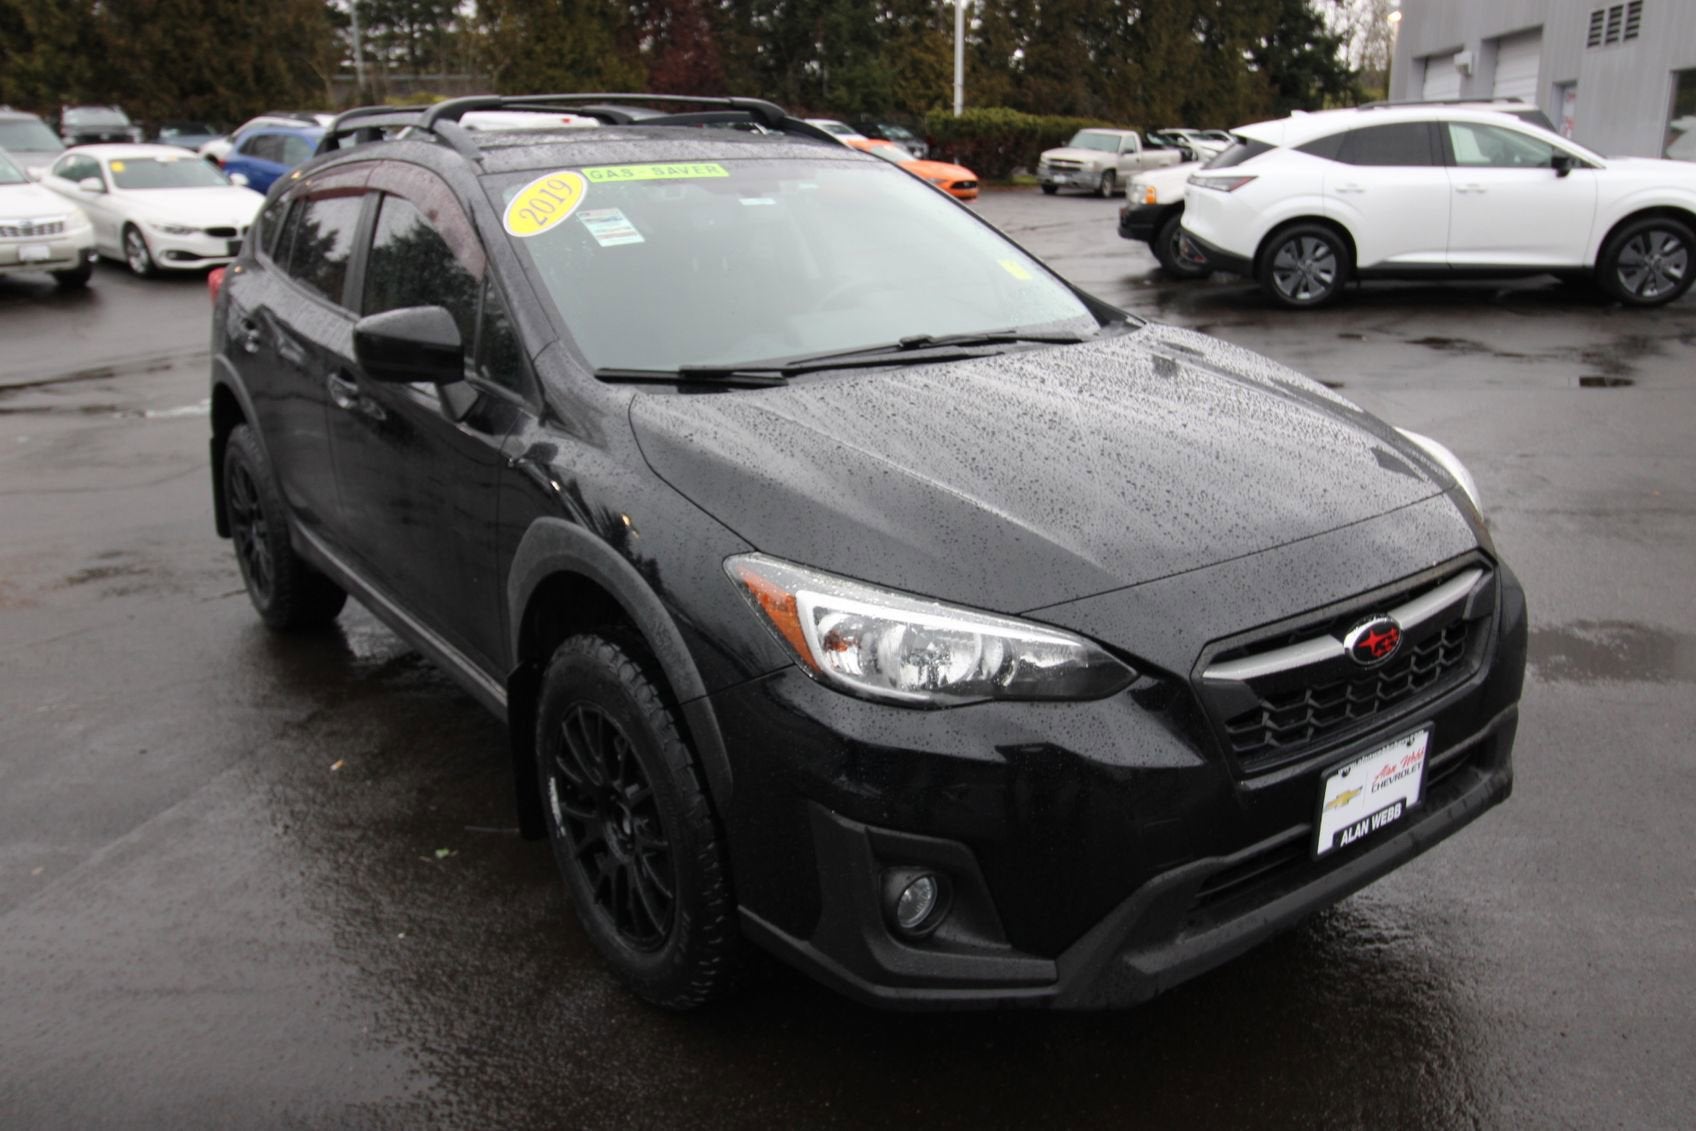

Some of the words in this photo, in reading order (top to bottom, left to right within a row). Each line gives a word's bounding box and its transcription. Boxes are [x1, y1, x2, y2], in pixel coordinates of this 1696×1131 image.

[589, 167, 634, 180] GAS
[651, 164, 720, 177] SAVER
[519, 178, 573, 226] 2019
[1371, 762, 1422, 793] CHEVROLET
[1340, 817, 1370, 848] ALAN
[1371, 802, 1402, 831] WEBB
